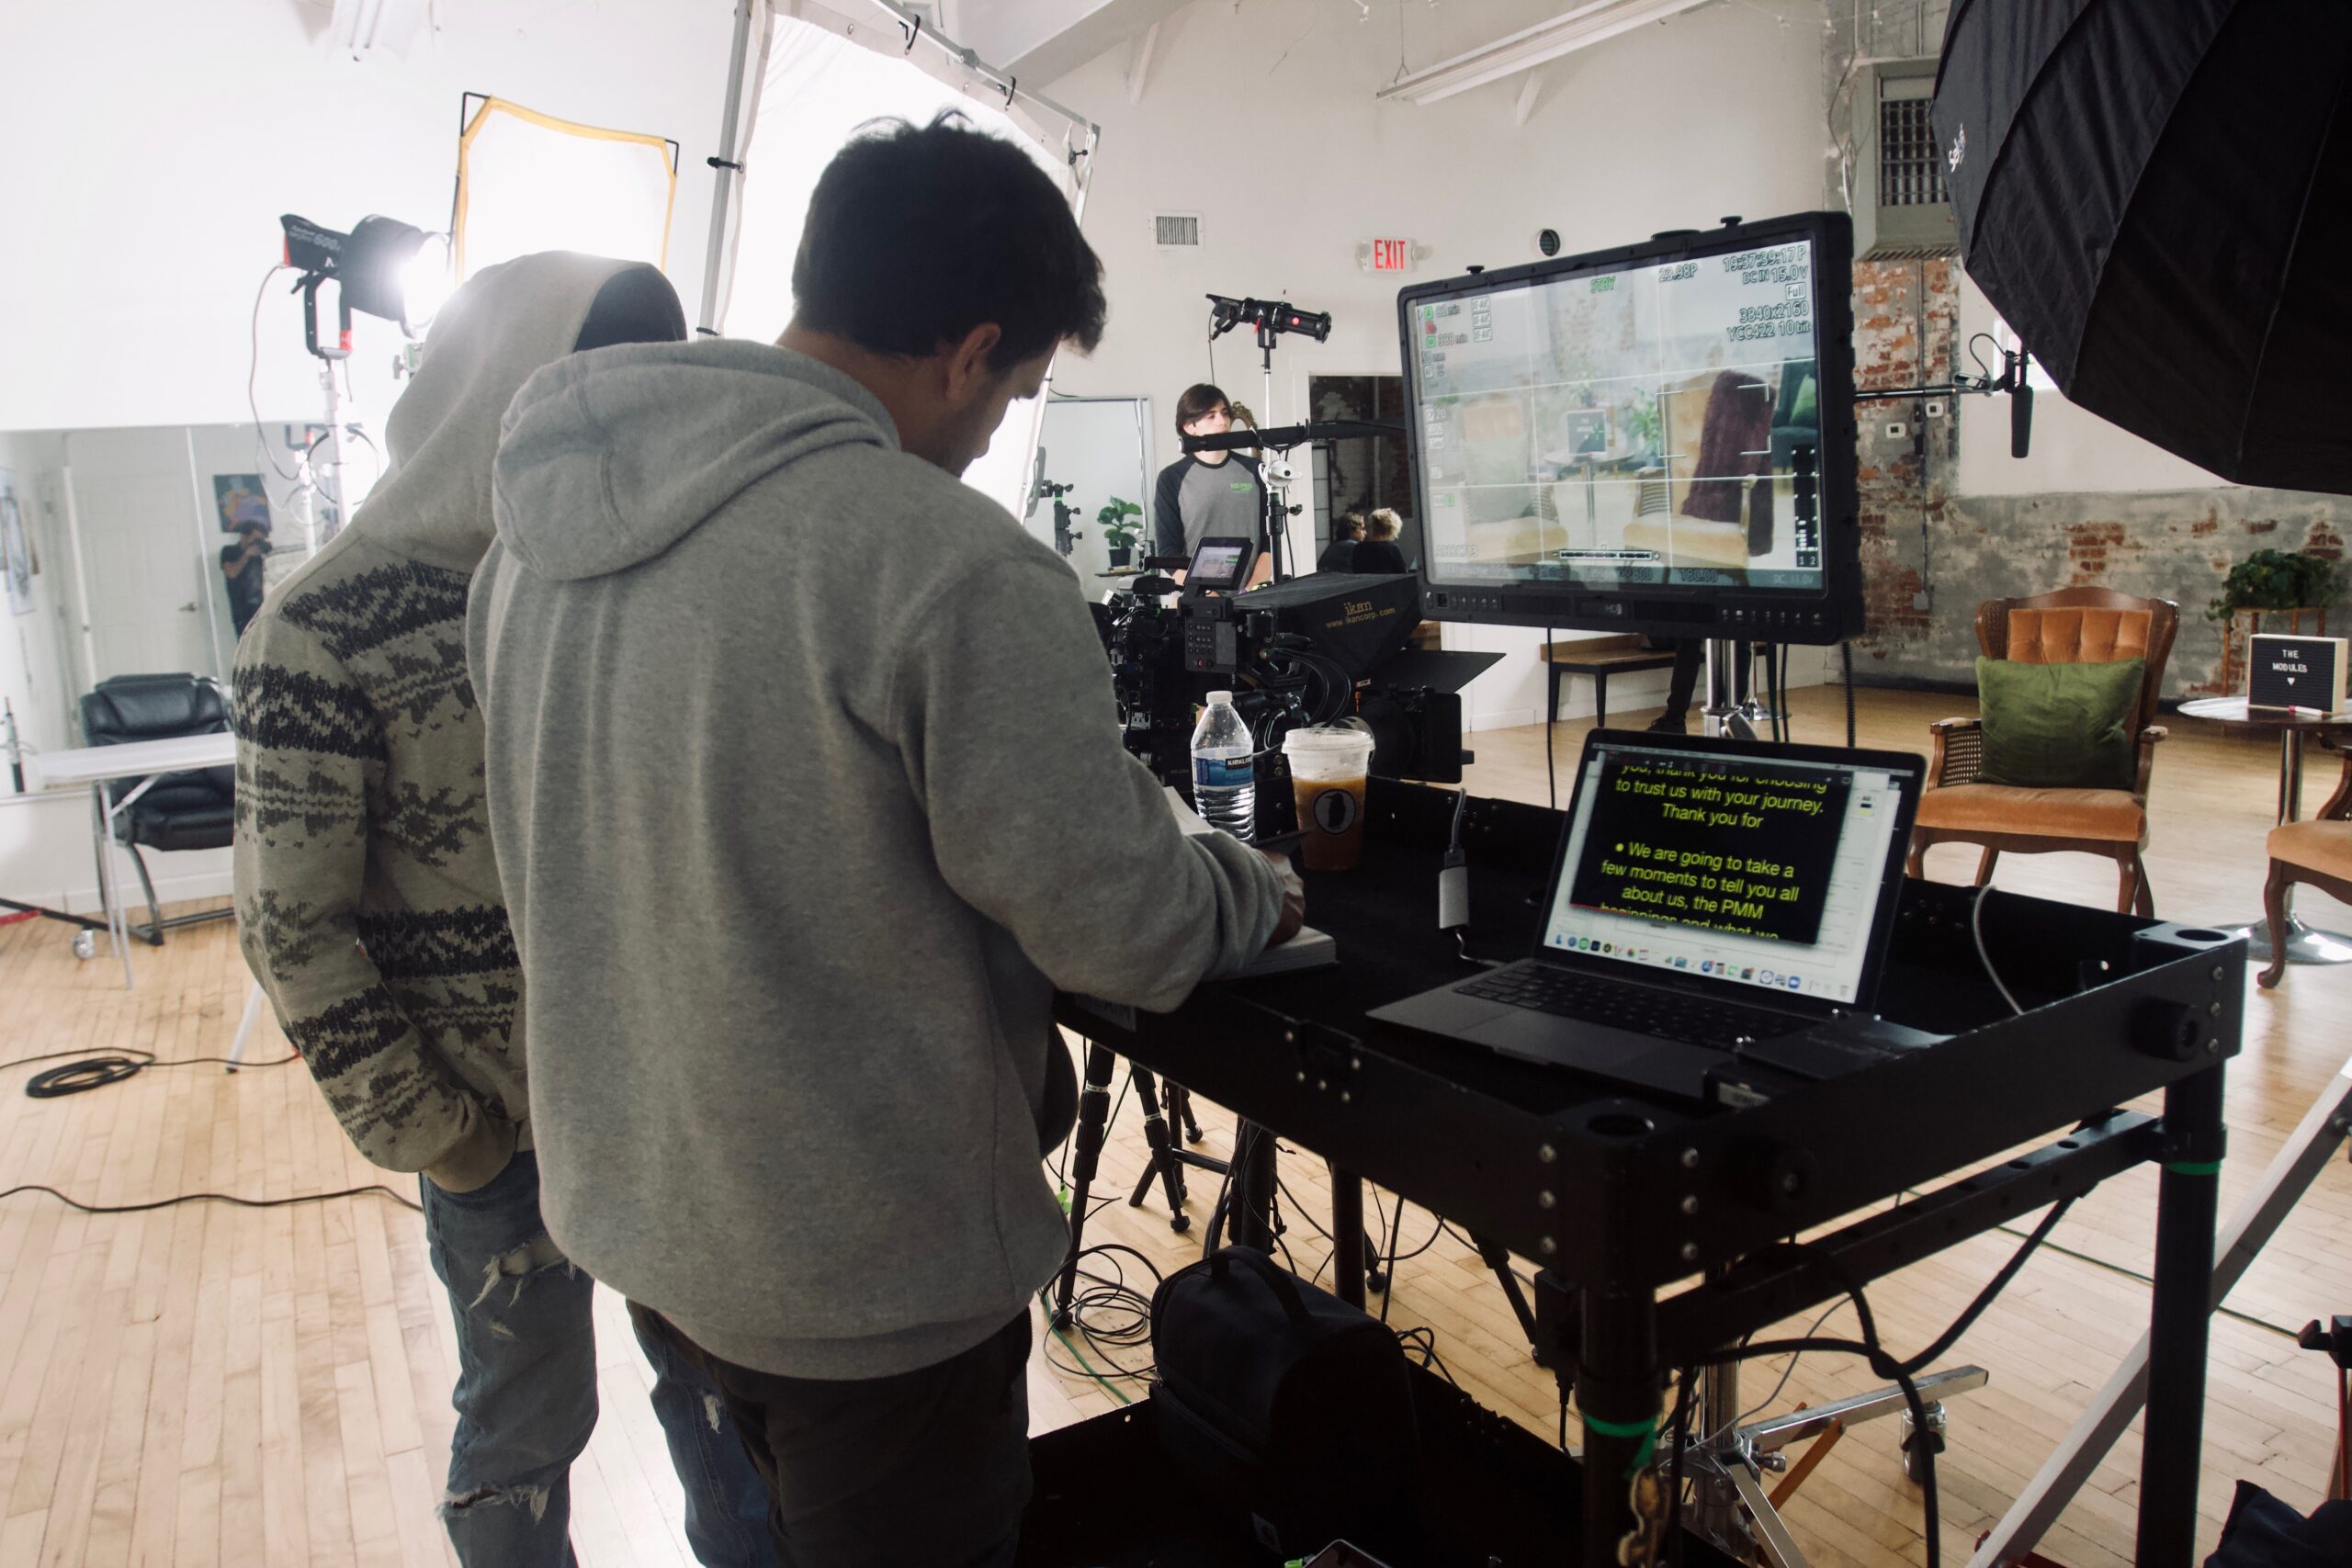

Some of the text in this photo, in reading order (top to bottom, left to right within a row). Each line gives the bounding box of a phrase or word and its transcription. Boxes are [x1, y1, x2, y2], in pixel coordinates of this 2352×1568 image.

[1374, 240, 1405, 269] EXIT
[1590, 276, 1616, 293] STBY
[1788, 286, 1805, 299] Full
[1739, 301, 1809, 322] 3840x2160
[1727, 325, 1775, 342] YCC422
[1326, 607, 1396, 628] www.ikancorp.com
[1343, 601, 1374, 615] ikan
[2282, 649, 2300, 659] THE
[2272, 662, 2308, 673] MODULES
[1615, 778, 1824, 814] to trust us with your journey.
[1661, 803, 1764, 828] Thank you for
[1628, 842, 1794, 877] We are going to take a
[1601, 860, 1800, 902] few moments to tell you all
[1622, 886, 1764, 919] about us, the PMM
